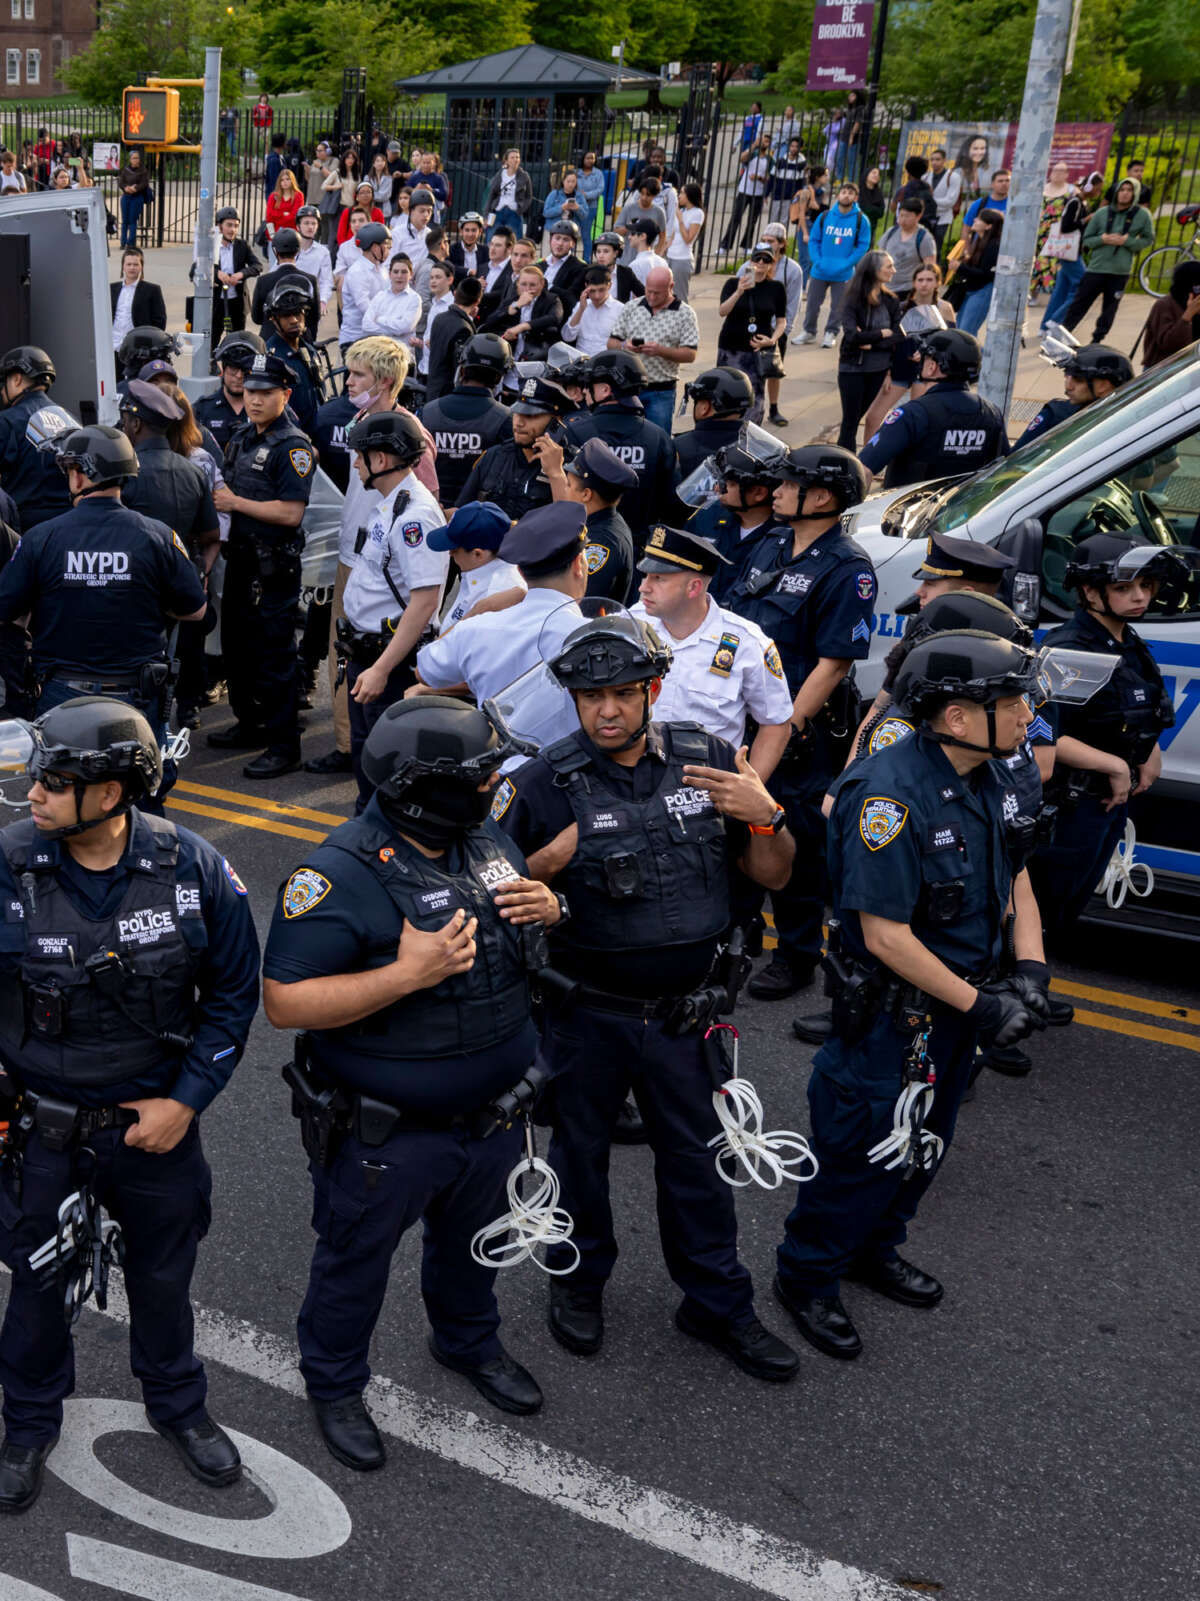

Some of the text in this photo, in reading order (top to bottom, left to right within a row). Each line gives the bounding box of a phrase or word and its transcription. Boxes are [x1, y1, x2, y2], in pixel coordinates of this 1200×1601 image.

[841, 6, 856, 23] BE
[818, 23, 866, 40] BROOKLYN.
[825, 225, 853, 237] ITALIA
[435, 432, 482, 450] NYPD
[944, 430, 986, 446] NYPD
[608, 446, 645, 465] YPD
[67, 551, 129, 573] NYPD
[99, 573, 131, 581] RESPONSE
[781, 573, 813, 587] POLICE
[664, 790, 710, 807] POLICE
[873, 801, 897, 810] POLICE
[865, 806, 902, 819] DEPARTMENT
[37, 854, 49, 863] S2
[140, 858, 152, 869] S2
[421, 889, 451, 903] OSBORNE
[134, 909, 153, 918] NYPD
[118, 911, 173, 935] POLICE
[119, 924, 177, 943] STRATEGIC RESPONSE
[139, 935, 161, 945] GROUP
[38, 938, 68, 947] GONZALEZ
